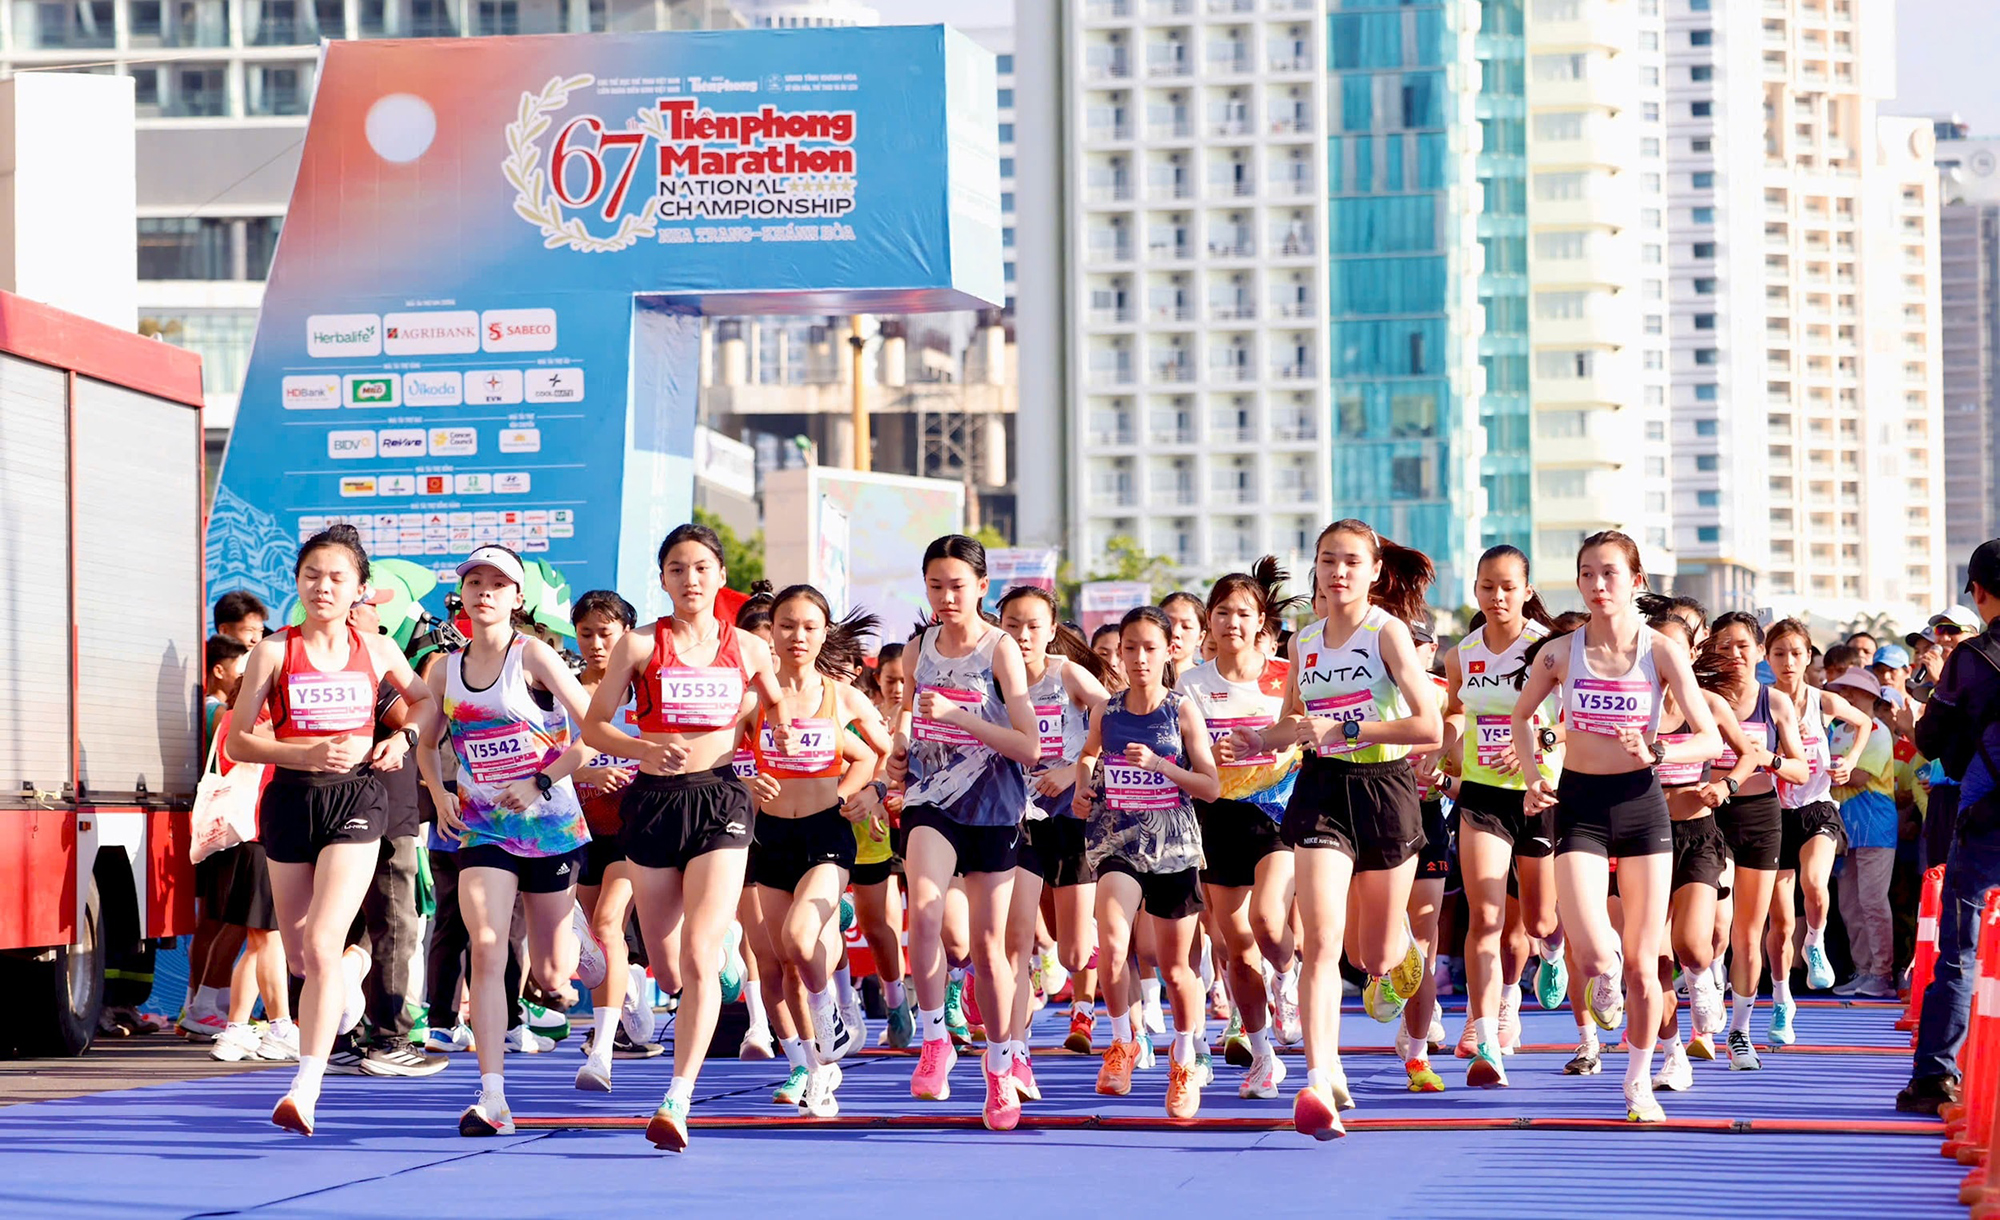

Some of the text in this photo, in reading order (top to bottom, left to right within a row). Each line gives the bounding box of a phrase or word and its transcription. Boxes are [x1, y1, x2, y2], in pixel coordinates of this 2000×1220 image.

[660, 143, 852, 176] Marathon
[660, 178, 786, 196] NATIONAL
[660, 198, 852, 216] CHAMPIONSHIP
[658, 228, 694, 243] NHA
[314, 330, 371, 343] Herbalife
[401, 327, 476, 340] AGRIBANK
[507, 325, 551, 336] SABECO
[286, 388, 326, 398] HDBank
[334, 439, 361, 450] BIDV
[1300, 665, 1372, 686] ANTA
[296, 686, 356, 704] Y5531
[669, 682, 728, 698] Y5532
[1578, 693, 1638, 711] Y5520
[469, 738, 521, 759] Y5542
[1110, 769, 1165, 785] Y5528
[1303, 837, 1318, 845] NIKE
